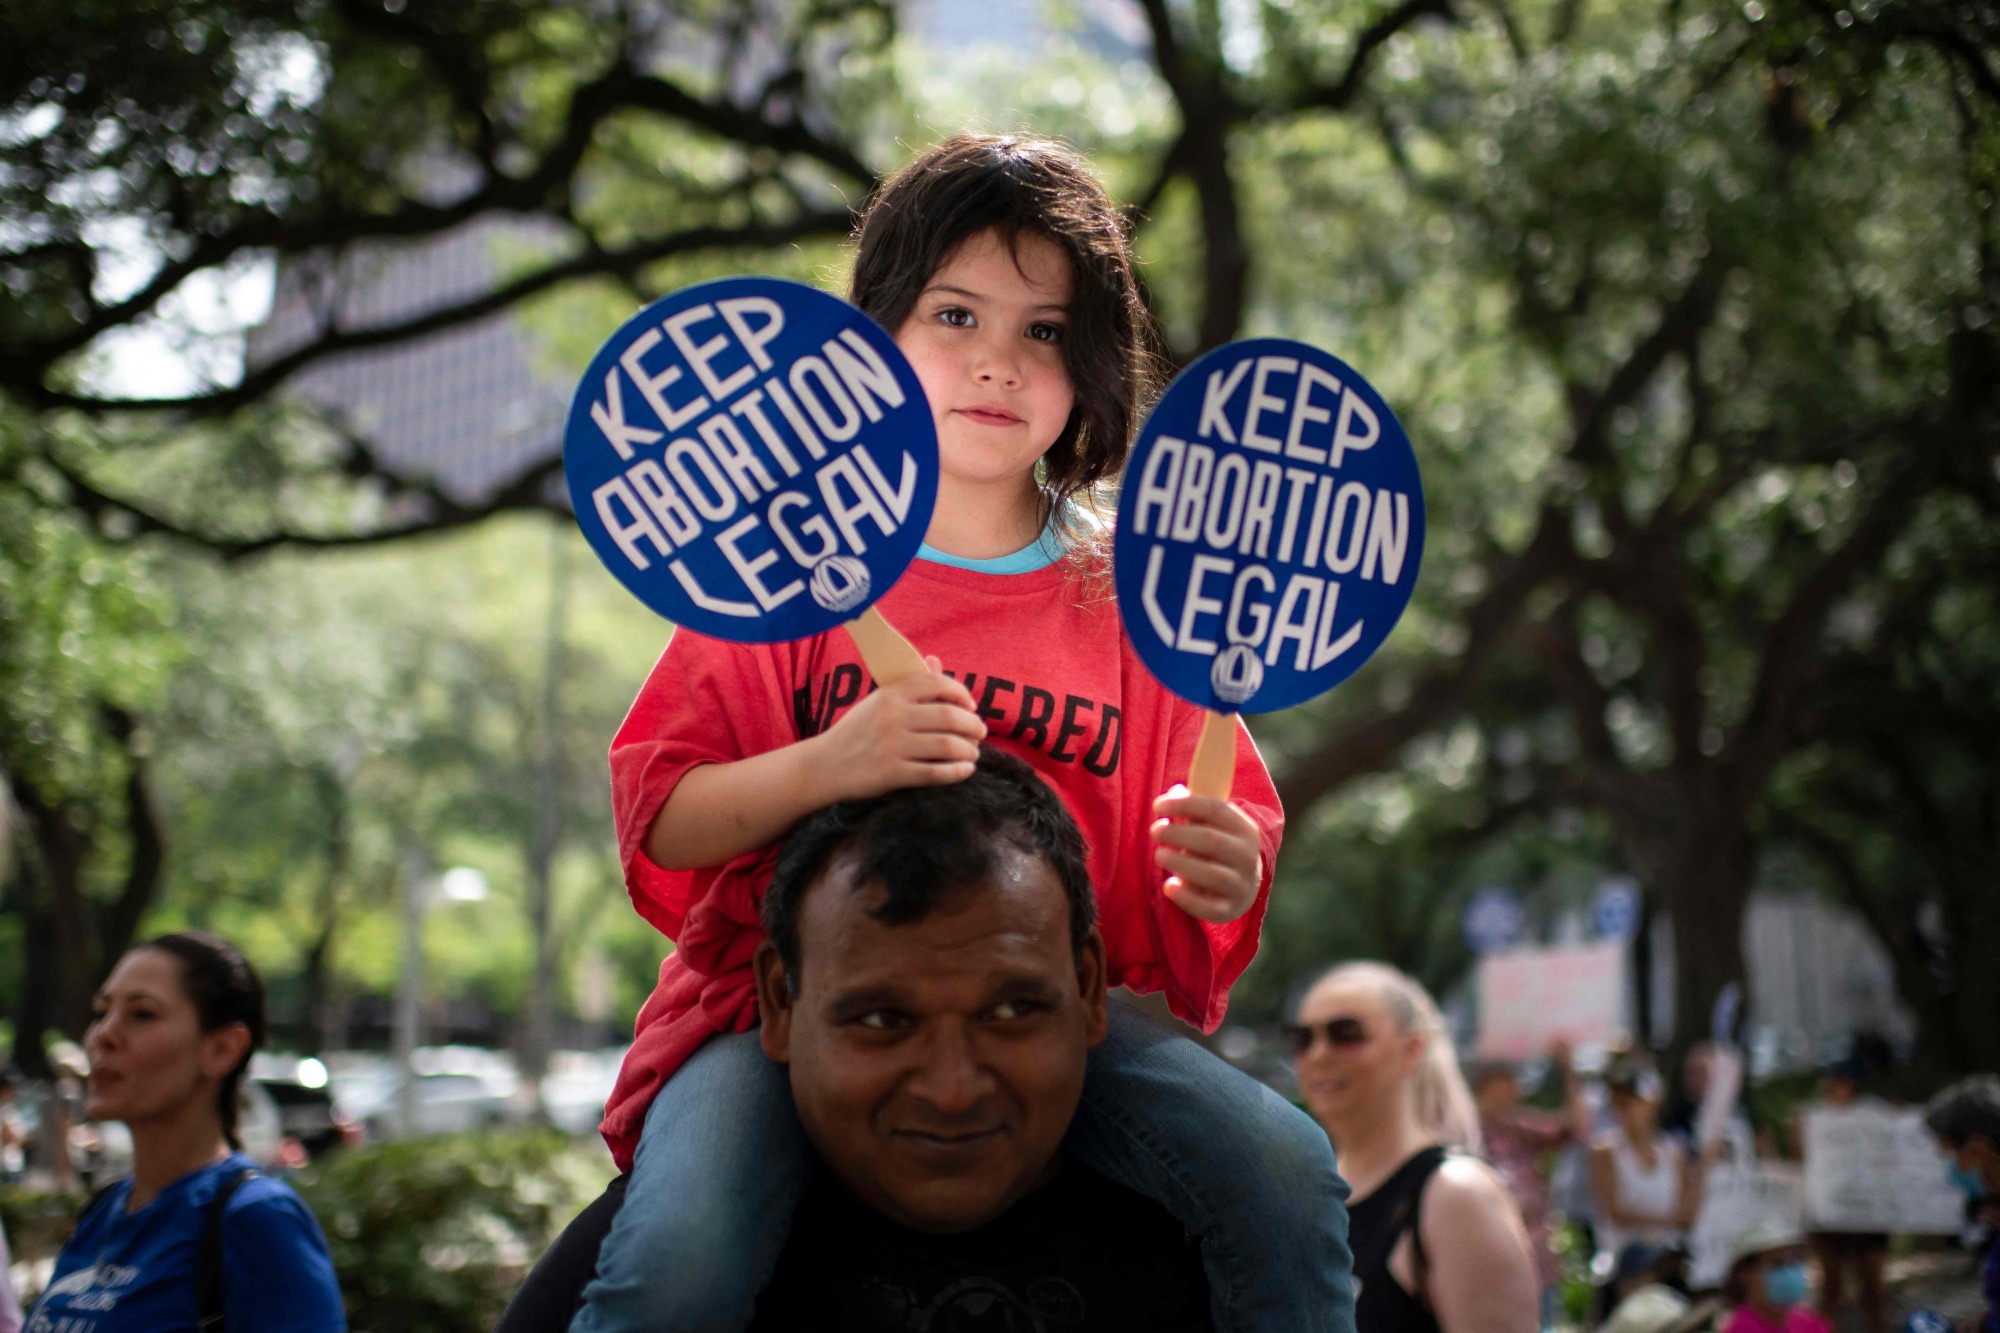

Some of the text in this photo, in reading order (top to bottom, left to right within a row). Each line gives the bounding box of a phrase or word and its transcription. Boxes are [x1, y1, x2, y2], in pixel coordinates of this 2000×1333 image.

[590, 296, 785, 461] KEEP
[591, 328, 907, 571] ABORTION
[1198, 356, 1381, 469] KEEP
[668, 443, 918, 618] LEGAL
[1133, 435, 1410, 586] ABORTION
[1141, 545, 1364, 672] LEGAL
